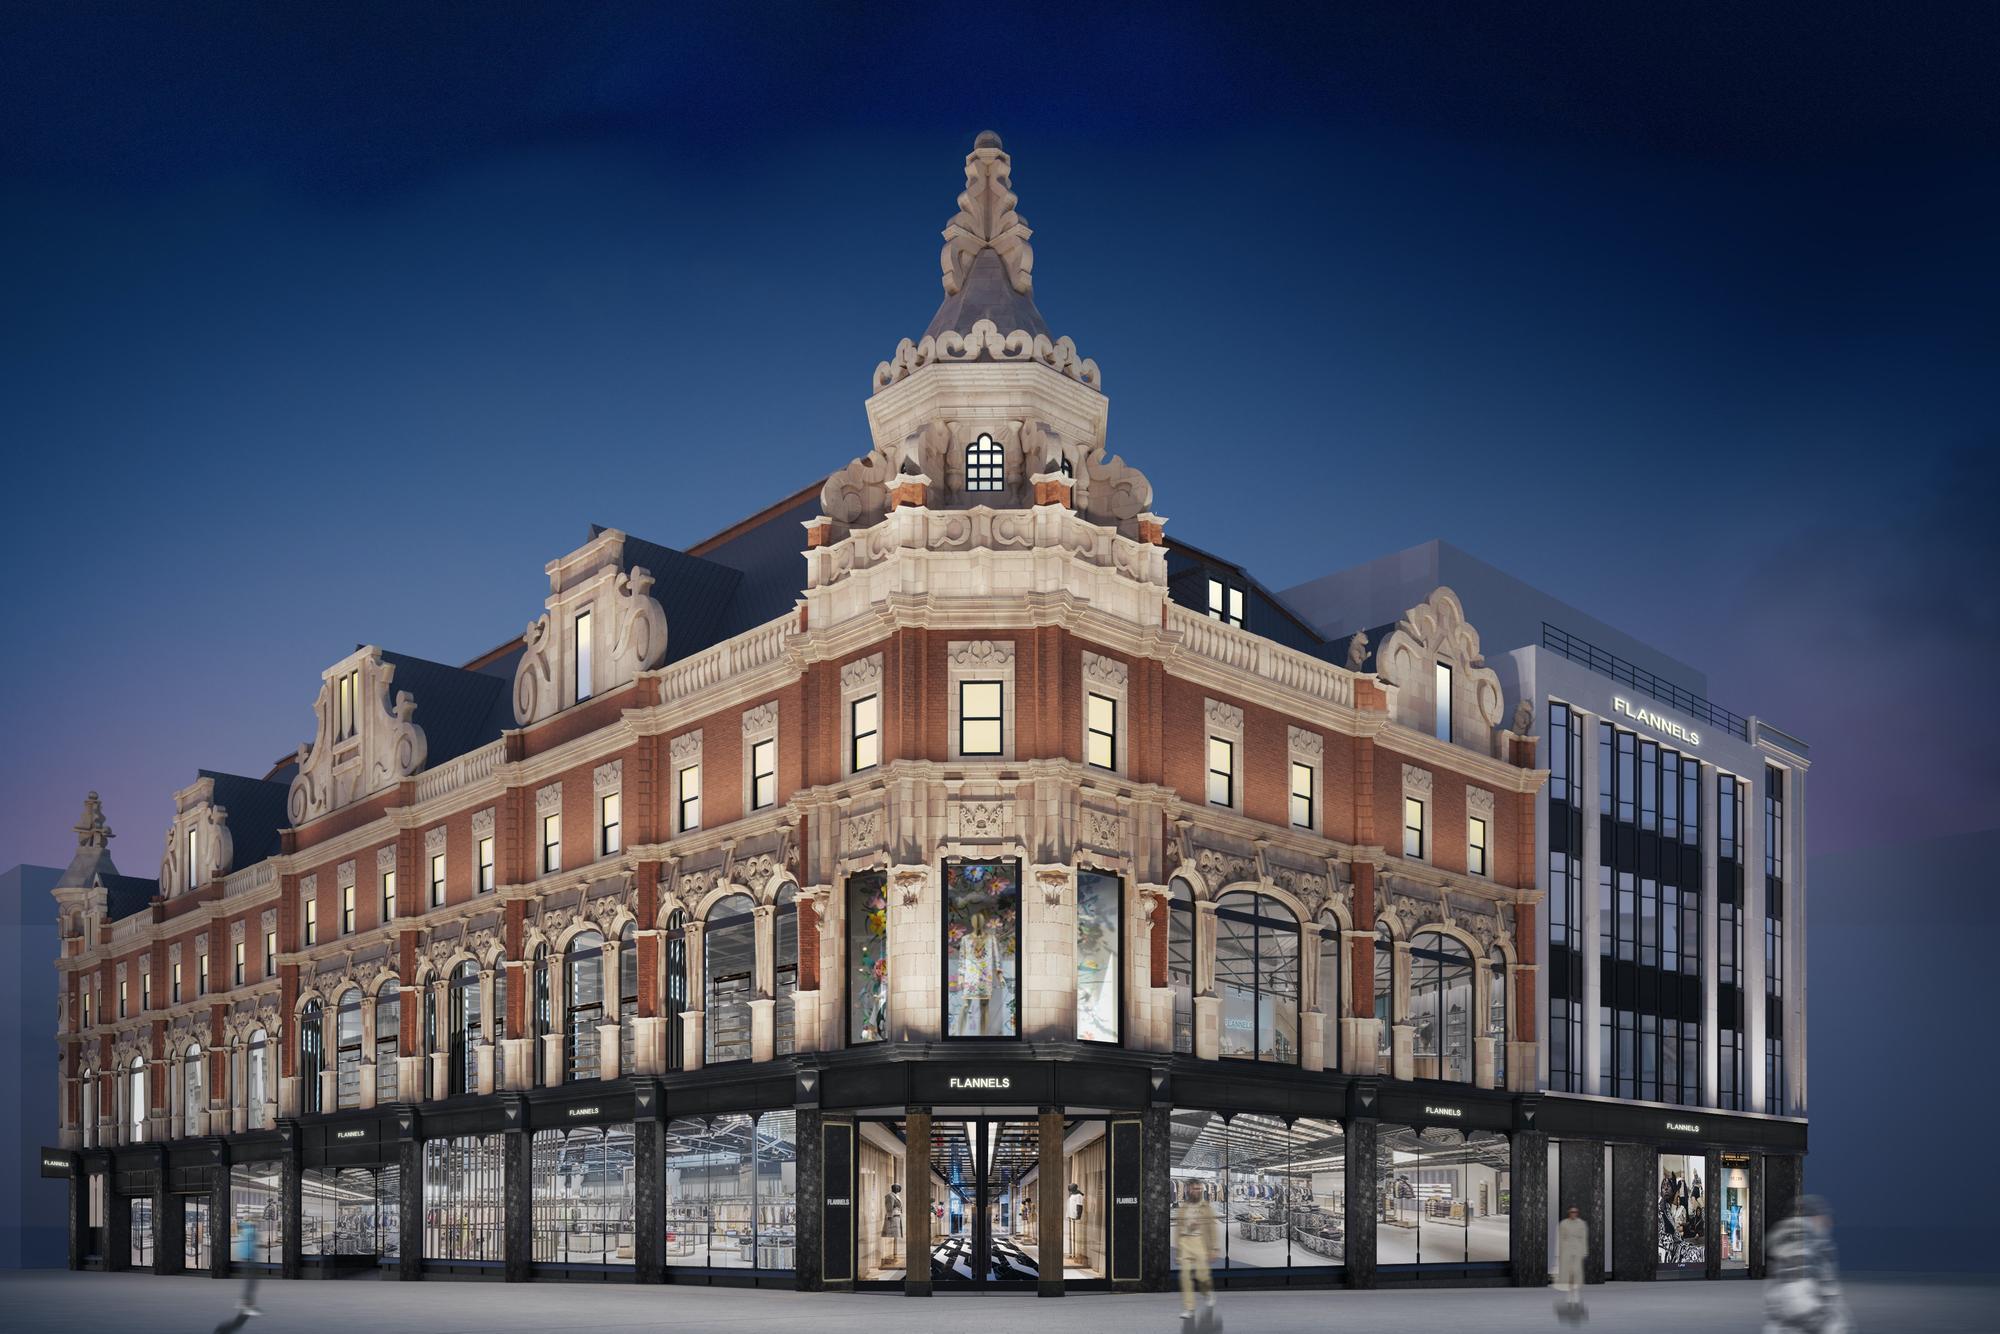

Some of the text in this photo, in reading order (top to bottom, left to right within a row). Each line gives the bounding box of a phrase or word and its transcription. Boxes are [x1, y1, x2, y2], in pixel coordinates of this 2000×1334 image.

[1613, 696, 1699, 745] FLANNELS
[950, 1078, 1010, 1088] FLANNELS
[569, 1107, 599, 1116] FLANNELS
[1425, 1106, 1461, 1116] FLANNELS
[1666, 1122, 1700, 1132] FLANNELS
[337, 1130, 365, 1138] FLANNELS
